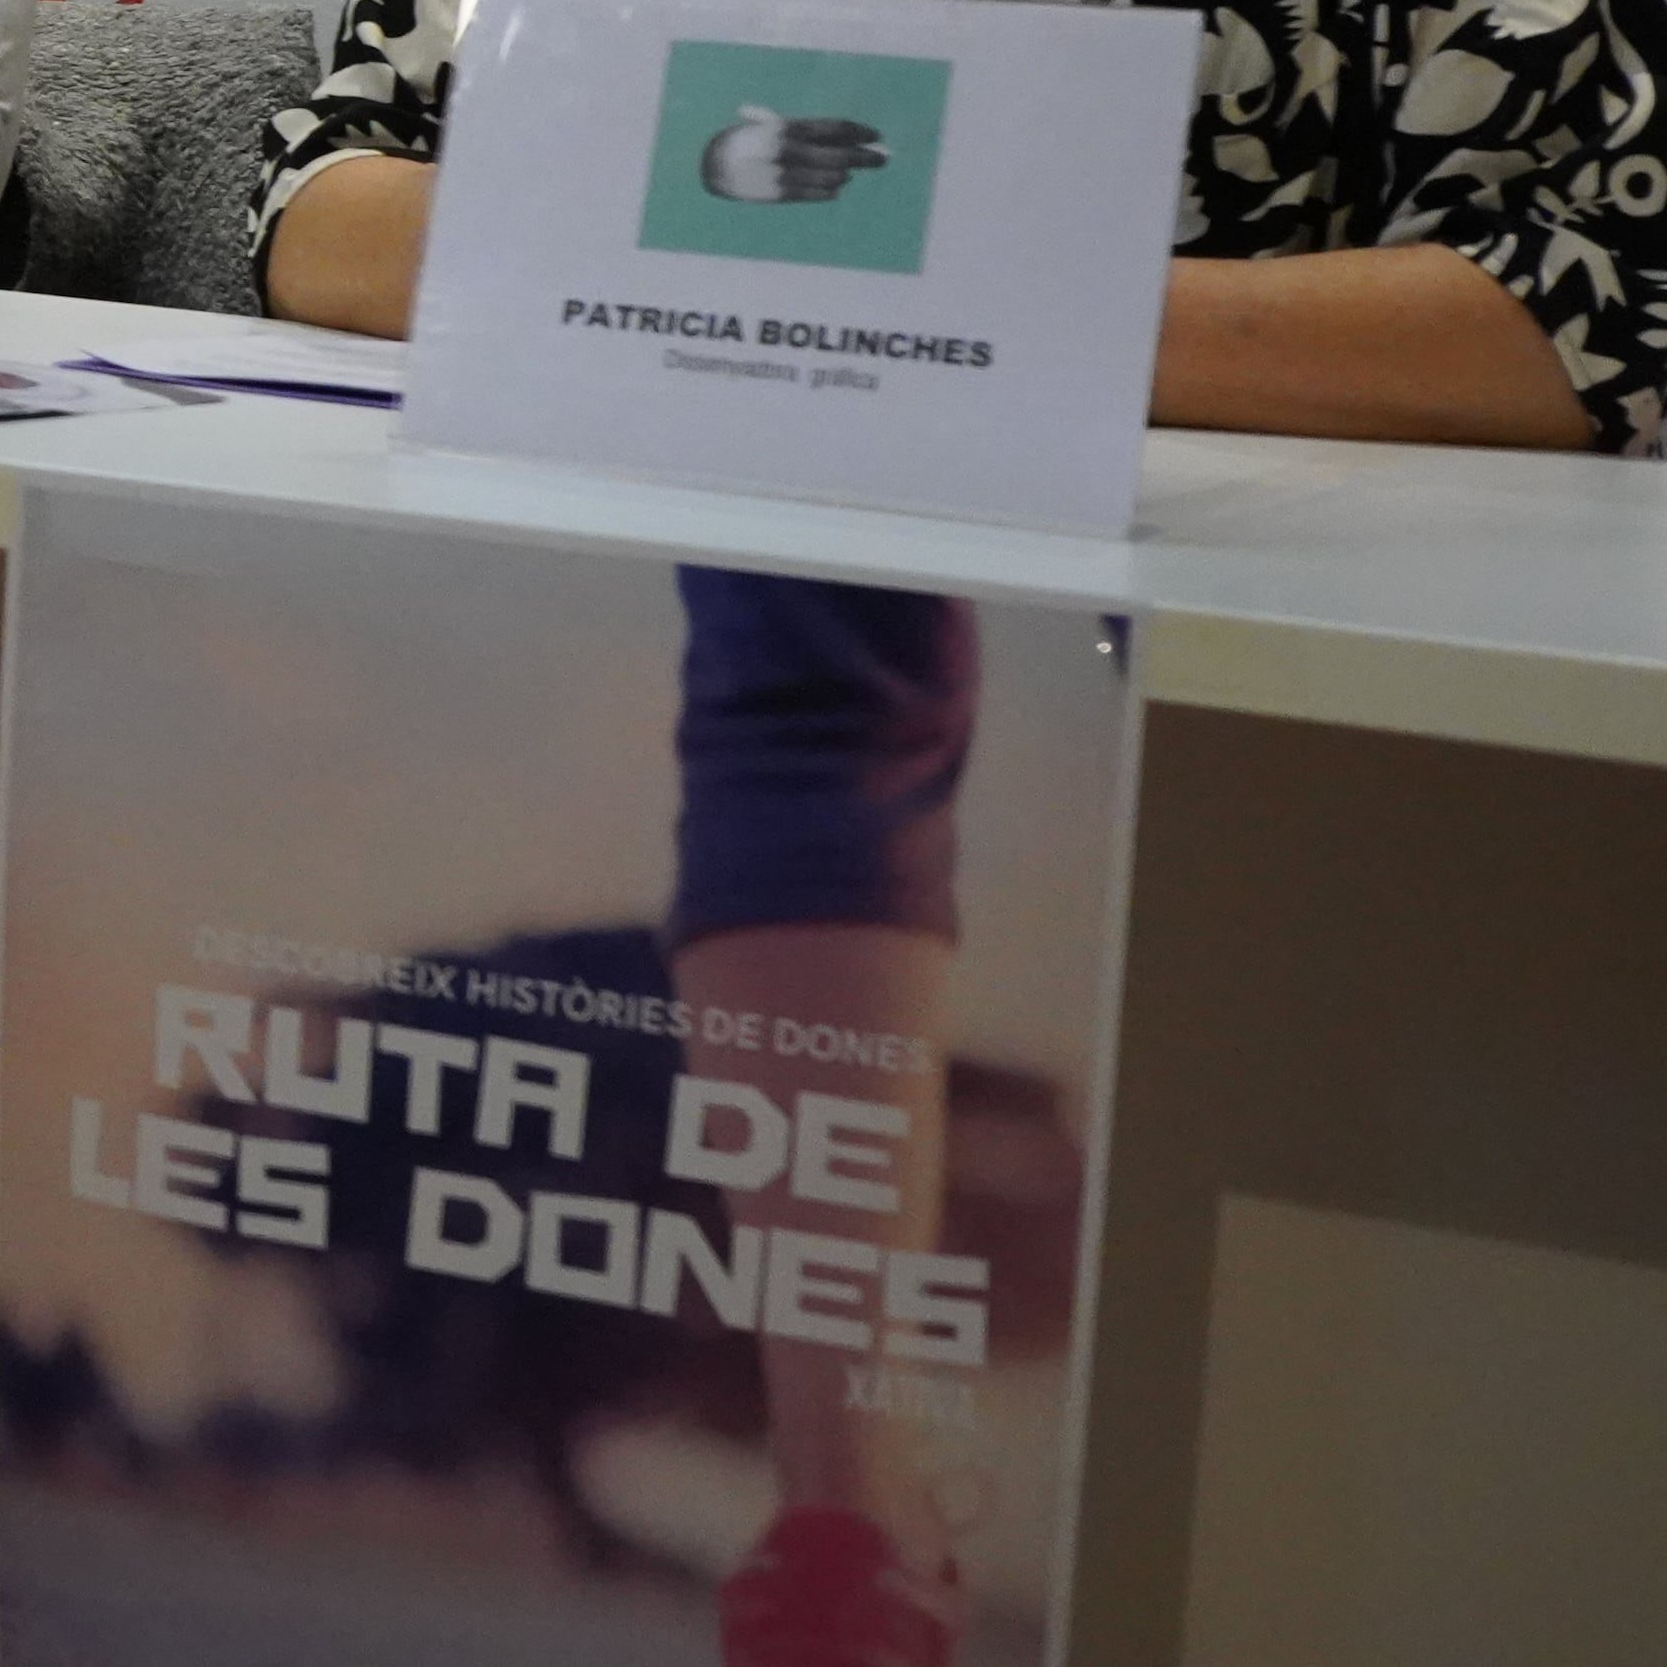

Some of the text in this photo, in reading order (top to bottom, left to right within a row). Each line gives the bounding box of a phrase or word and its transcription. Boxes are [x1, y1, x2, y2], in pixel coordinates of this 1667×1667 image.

[561, 298, 995, 370] PATRICIA BOLINCHES
[191, 925, 459, 1004] DESCOBREIX
[465, 968, 692, 1038] HISTÒRIES
[699, 1006, 762, 1050] DE
[153, 982, 911, 1215] RUTA DE
[68, 1094, 991, 1366] LES DONES
